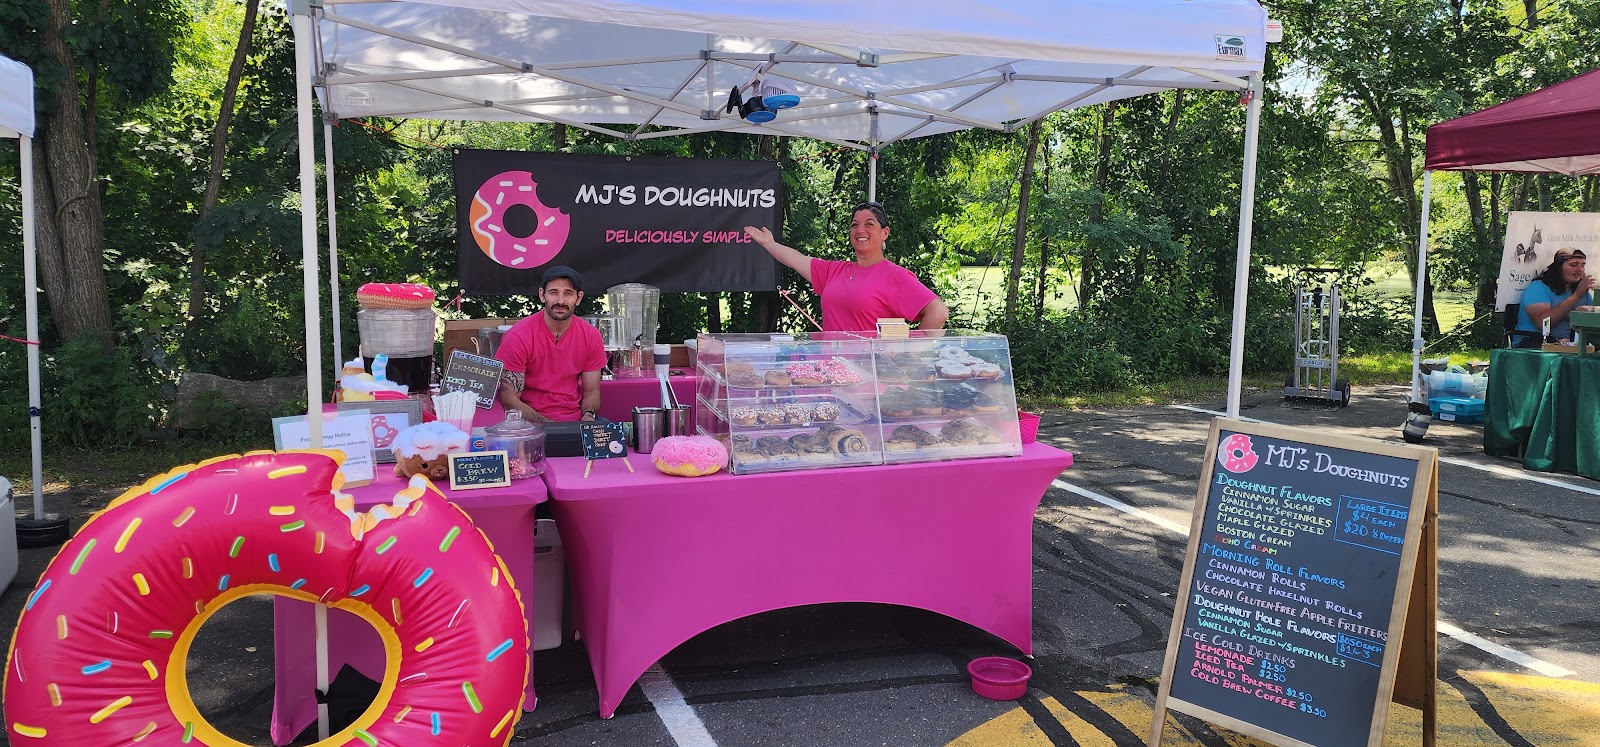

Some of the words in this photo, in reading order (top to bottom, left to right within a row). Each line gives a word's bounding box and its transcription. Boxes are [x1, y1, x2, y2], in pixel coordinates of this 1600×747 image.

[574, 184, 637, 206] MJ'S
[644, 186, 776, 208] DOUGHNUTS
[605, 229, 699, 244] DELICIOUSLY
[702, 230, 752, 244] SIMPLE
[1508, 270, 1530, 285] Sage
[452, 362, 498, 378] LEMONADE
[469, 380, 484, 390] TEA
[458, 462, 482, 470] COLD
[466, 466, 498, 476] BREW
[1312, 452, 1410, 488] DOUGHNUTS
[1216, 472, 1278, 496] DOUGHNUT
[1280, 485, 1333, 507] FLAVORS
[1222, 486, 1278, 505] CINNAMON
[1282, 499, 1315, 513] SUGAR
[1222, 495, 1262, 511] VANILLA
[1218, 502, 1275, 524] CHOCOLATE
[1280, 519, 1324, 535] GLAZED
[1347, 500, 1377, 513] LARGE
[1378, 506, 1408, 520] ITEMS
[1352, 510, 1369, 522] $4
[1372, 518, 1396, 528] EACH
[1216, 523, 1256, 540] BOSTON
[1260, 534, 1292, 548] CREAM
[1217, 512, 1251, 527] MAPLE
[1254, 520, 1295, 538] GLAZED
[1344, 520, 1368, 536] $20
[1379, 532, 1404, 544] DOZEN
[1244, 540, 1277, 556] CREAM
[1202, 542, 1260, 567] MORNING
[1266, 558, 1293, 576] ROLL
[1298, 567, 1346, 590] FLAVORS
[1208, 558, 1266, 580] CINNAMON
[1272, 572, 1306, 591] ROLLS
[1205, 569, 1263, 593] CHOCOLATE
[1268, 586, 1320, 607] HAZELNUT
[1325, 600, 1364, 620] ROLLS
[1194, 594, 1252, 619] DOUGHNUT
[1254, 610, 1282, 628] HOLE
[1287, 620, 1337, 644] FLAVORS
[1196, 580, 1234, 600] VEGAN
[1236, 590, 1297, 616] GLUTEN-FREE
[1300, 607, 1335, 628] APPLE
[1338, 618, 1388, 641] FRITTERS
[1198, 608, 1251, 628] CINNAMON
[1254, 622, 1284, 638] SUGAR
[1197, 618, 1237, 636] VANILLA
[1239, 629, 1276, 646] GLAZED
[1184, 627, 1208, 643] ICE
[1212, 634, 1244, 652] COLD
[1248, 645, 1296, 669] DRINKS
[1195, 642, 1254, 666] LEMONADE
[1260, 659, 1286, 673] $2.50
[1195, 651, 1221, 666] ICED
[1224, 659, 1245, 672] TEA
[1259, 669, 1286, 683] $2.50
[1190, 669, 1220, 685] COLD
[1222, 678, 1252, 696] BREW
[1255, 689, 1296, 710] COFFEE
[1300, 702, 1327, 718] $3.50
[1193, 661, 1236, 680] ARNOLD
[1241, 674, 1283, 695] PALMER
[1286, 687, 1313, 702] $2.50
